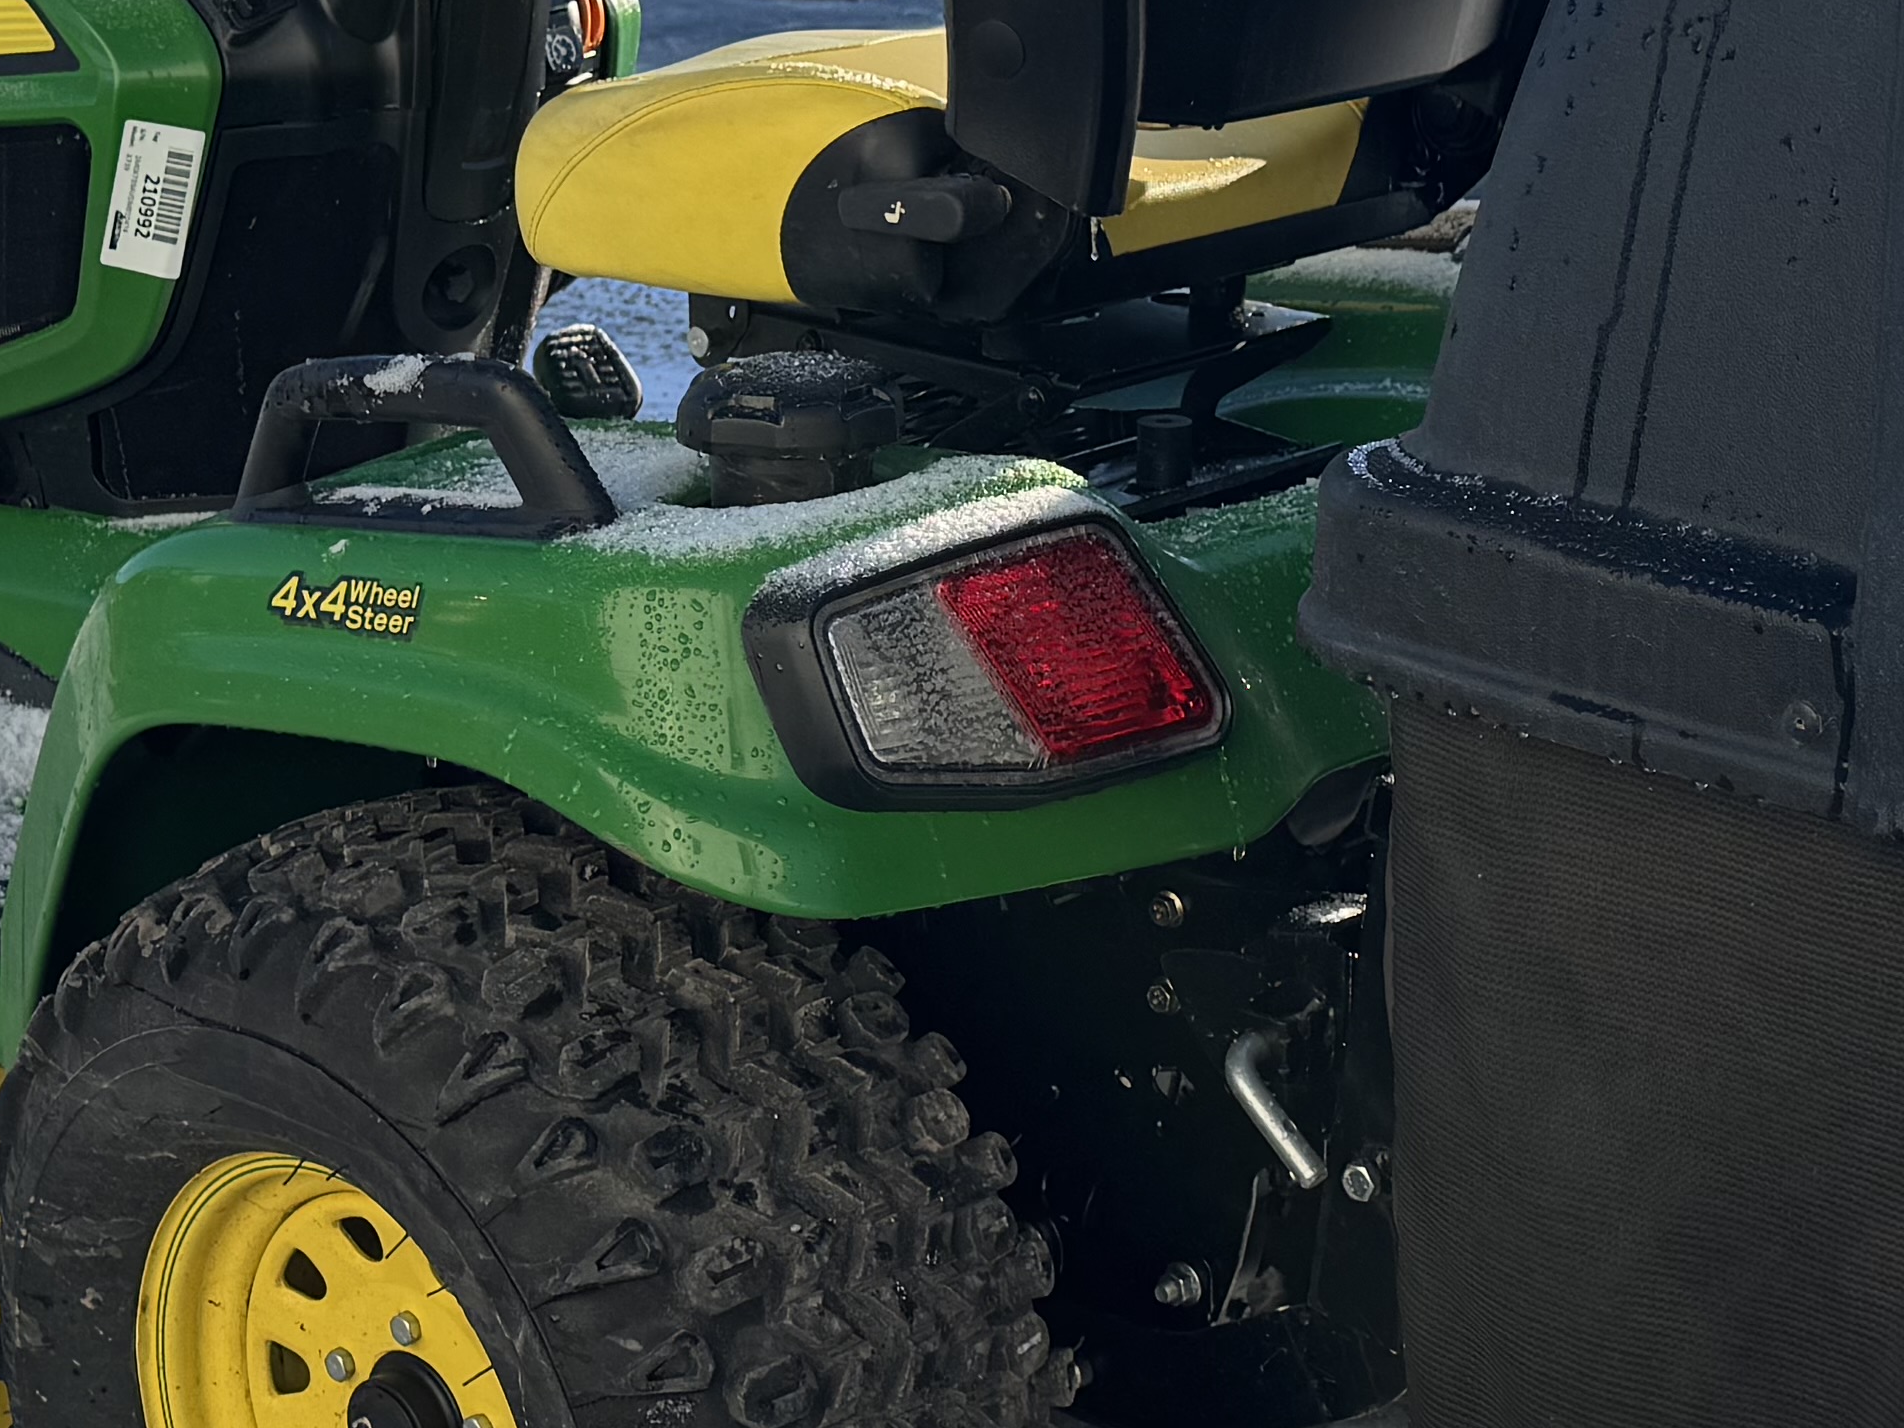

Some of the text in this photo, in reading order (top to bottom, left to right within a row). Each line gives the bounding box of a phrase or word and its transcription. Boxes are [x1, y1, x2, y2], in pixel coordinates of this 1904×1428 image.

[134, 174, 161, 240] 210992
[270, 575, 421, 621] 4x4 Wheel
[345, 604, 415, 635] Steer
